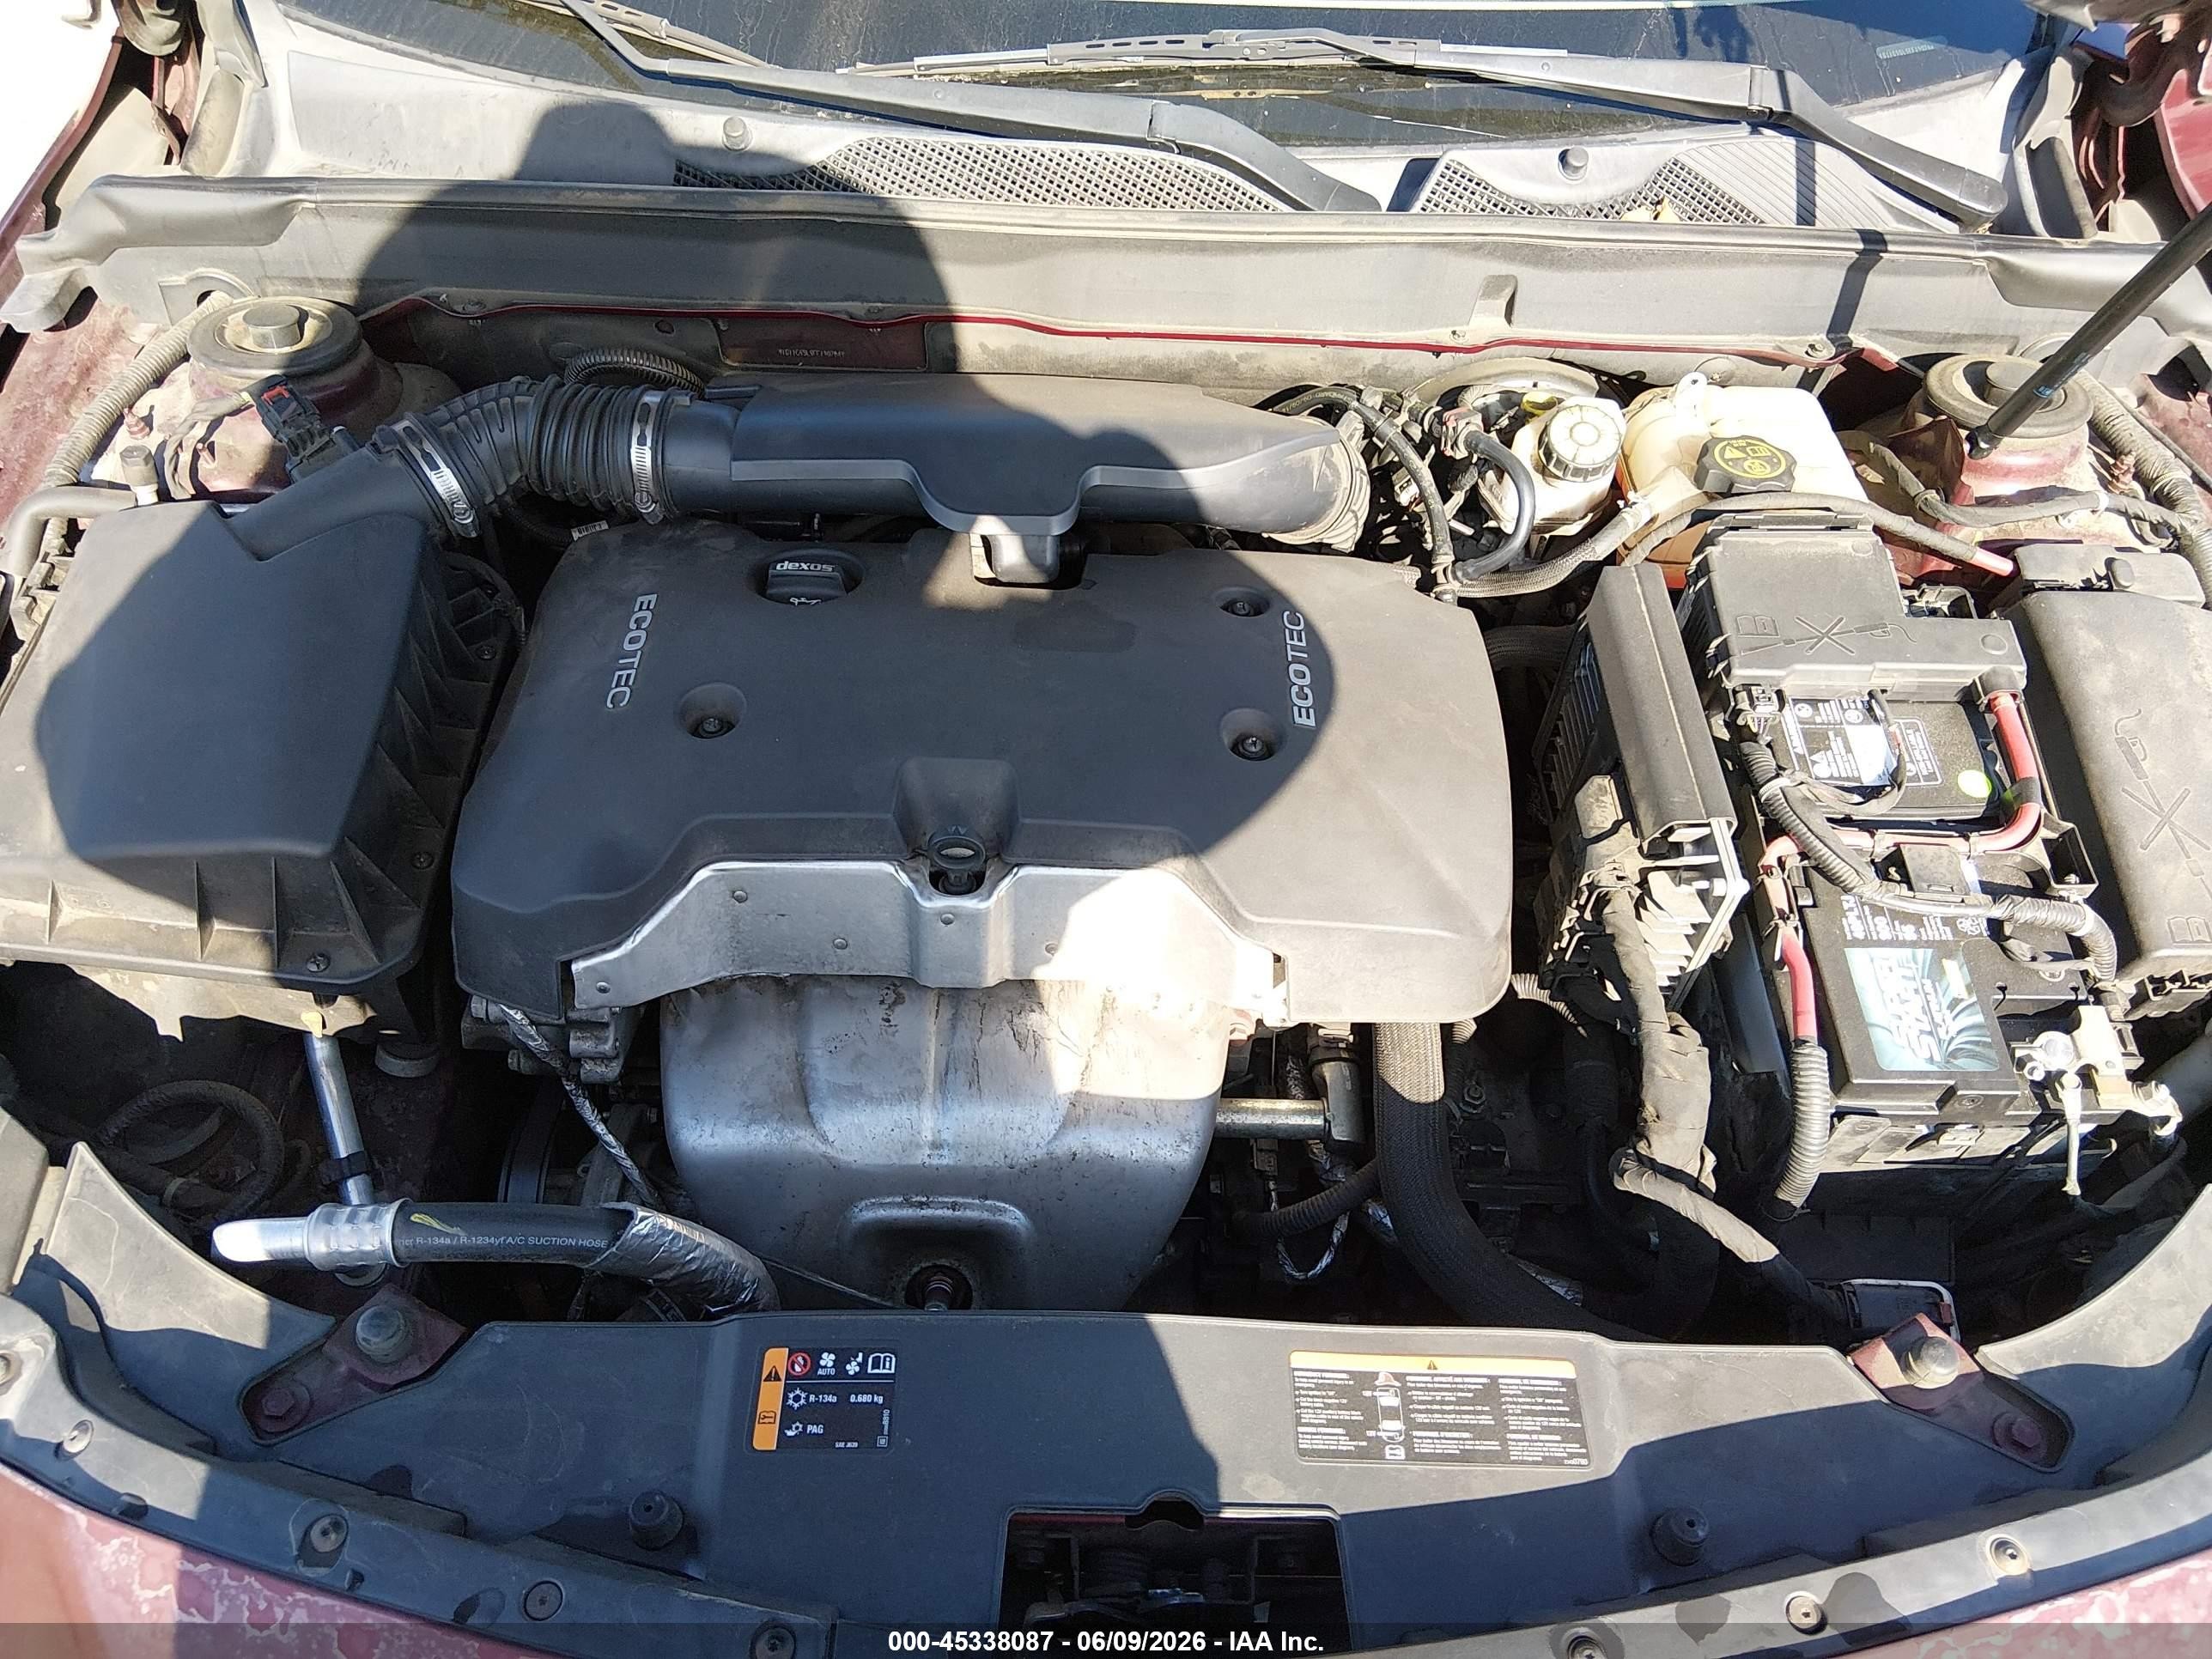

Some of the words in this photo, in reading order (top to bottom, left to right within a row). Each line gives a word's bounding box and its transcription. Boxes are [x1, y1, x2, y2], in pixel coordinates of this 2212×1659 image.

[776, 561, 835, 572] dexos
[606, 593, 658, 708] ECOTEC
[1283, 611, 1316, 726] ECOTEC
[453, 1237, 458, 1245] /
[460, 1237, 507, 1245] R-1234yf
[528, 1237, 575, 1246] SUCTION
[579, 1238, 608, 1249] HOSE
[809, 1395, 837, 1403] R-134a
[849, 1395, 872, 1403] 0.680
[873, 1395, 884, 1404] kg
[806, 1425, 824, 1434] PAG
